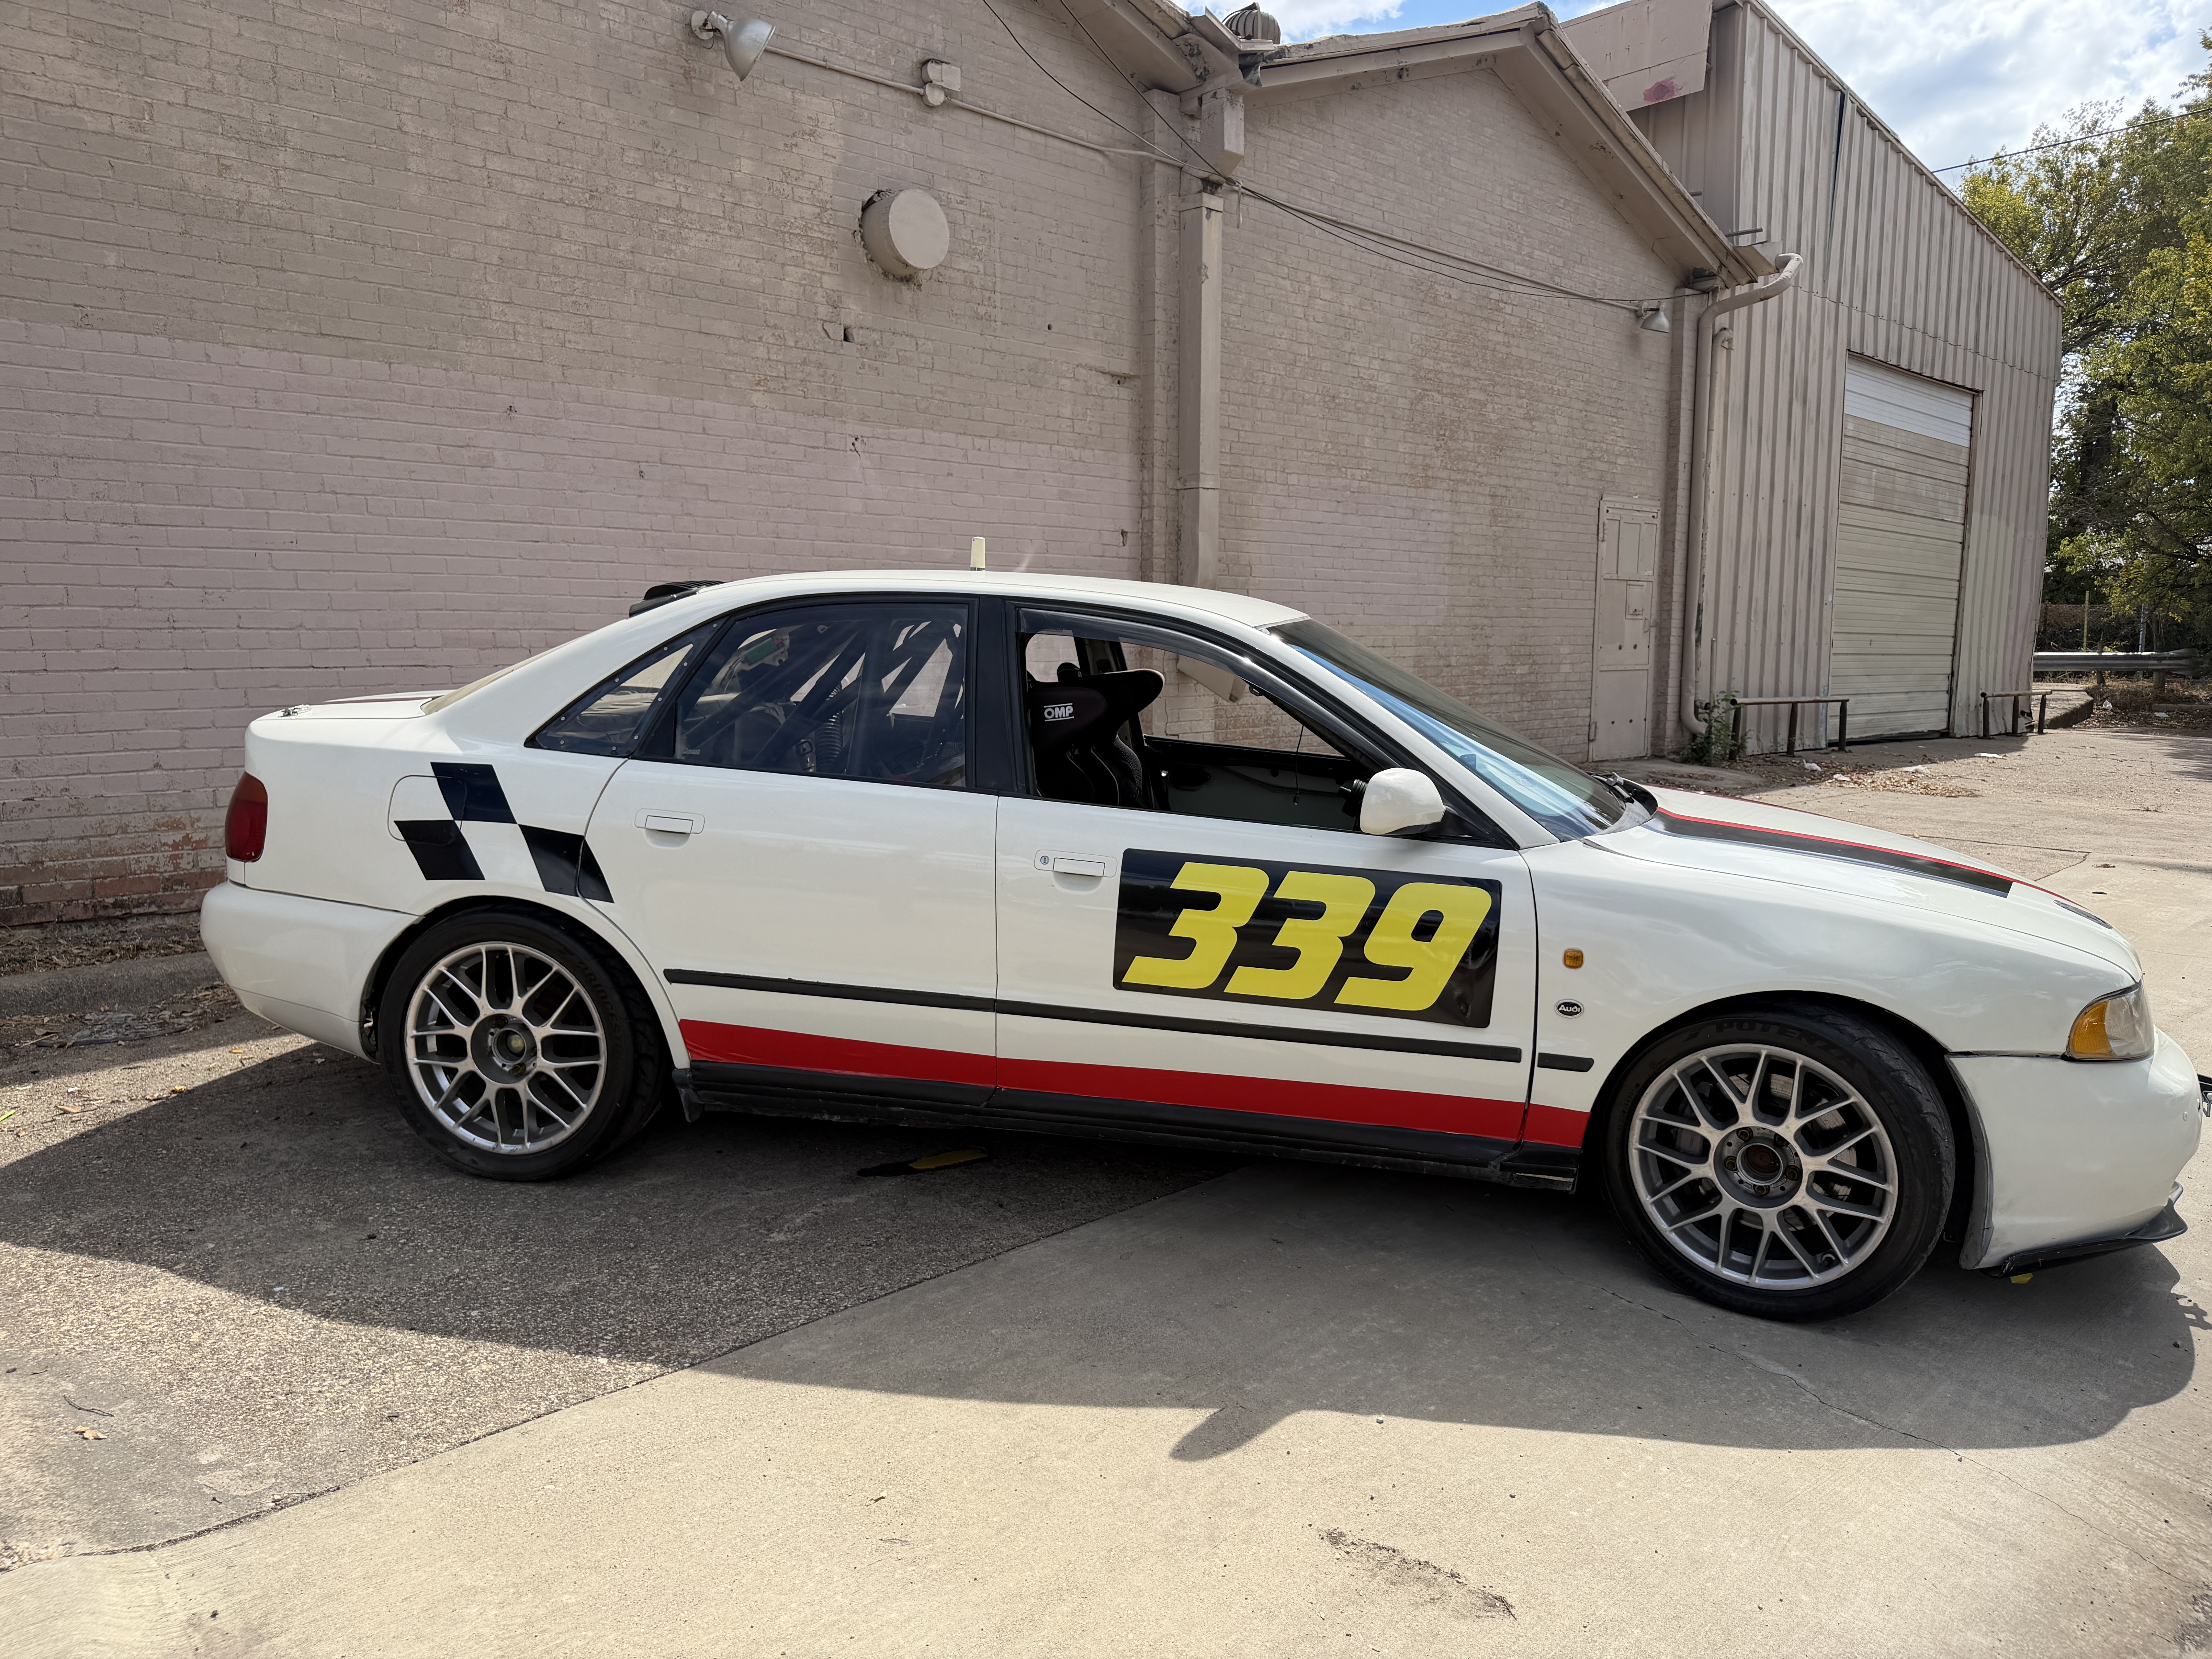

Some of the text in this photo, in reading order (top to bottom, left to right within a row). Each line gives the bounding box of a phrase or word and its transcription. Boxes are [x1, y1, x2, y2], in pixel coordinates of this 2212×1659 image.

[1044, 705, 1073, 719] OMP
[1121, 862, 1492, 1011] 339
[1716, 1020, 1860, 1068] POTENZA
